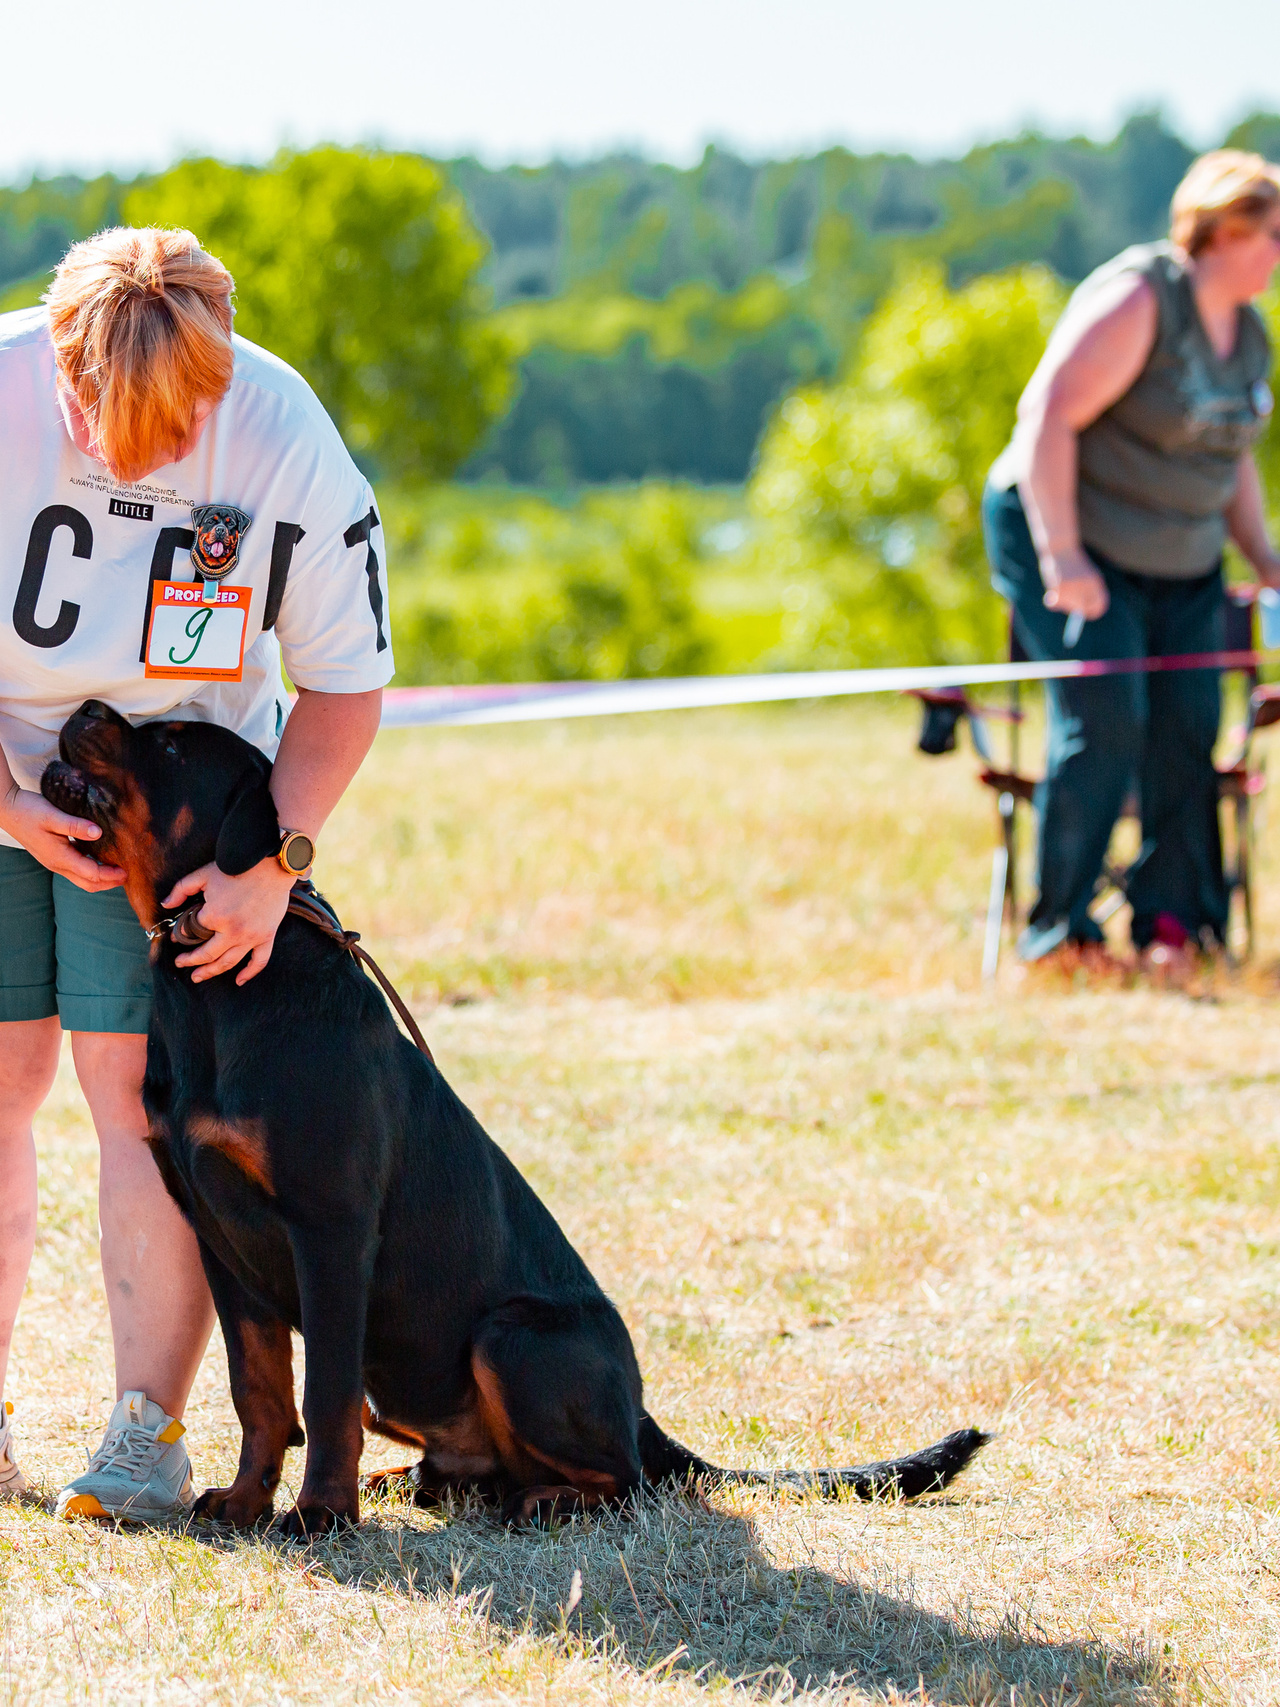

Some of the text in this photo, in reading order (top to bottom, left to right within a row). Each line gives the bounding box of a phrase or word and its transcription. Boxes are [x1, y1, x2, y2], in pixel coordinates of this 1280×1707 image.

[69, 477, 94, 489] ALWAYS
[95, 485, 143, 500] INFLUENCING
[143, 494, 160, 502] AND
[113, 501, 149, 518] LITTLE
